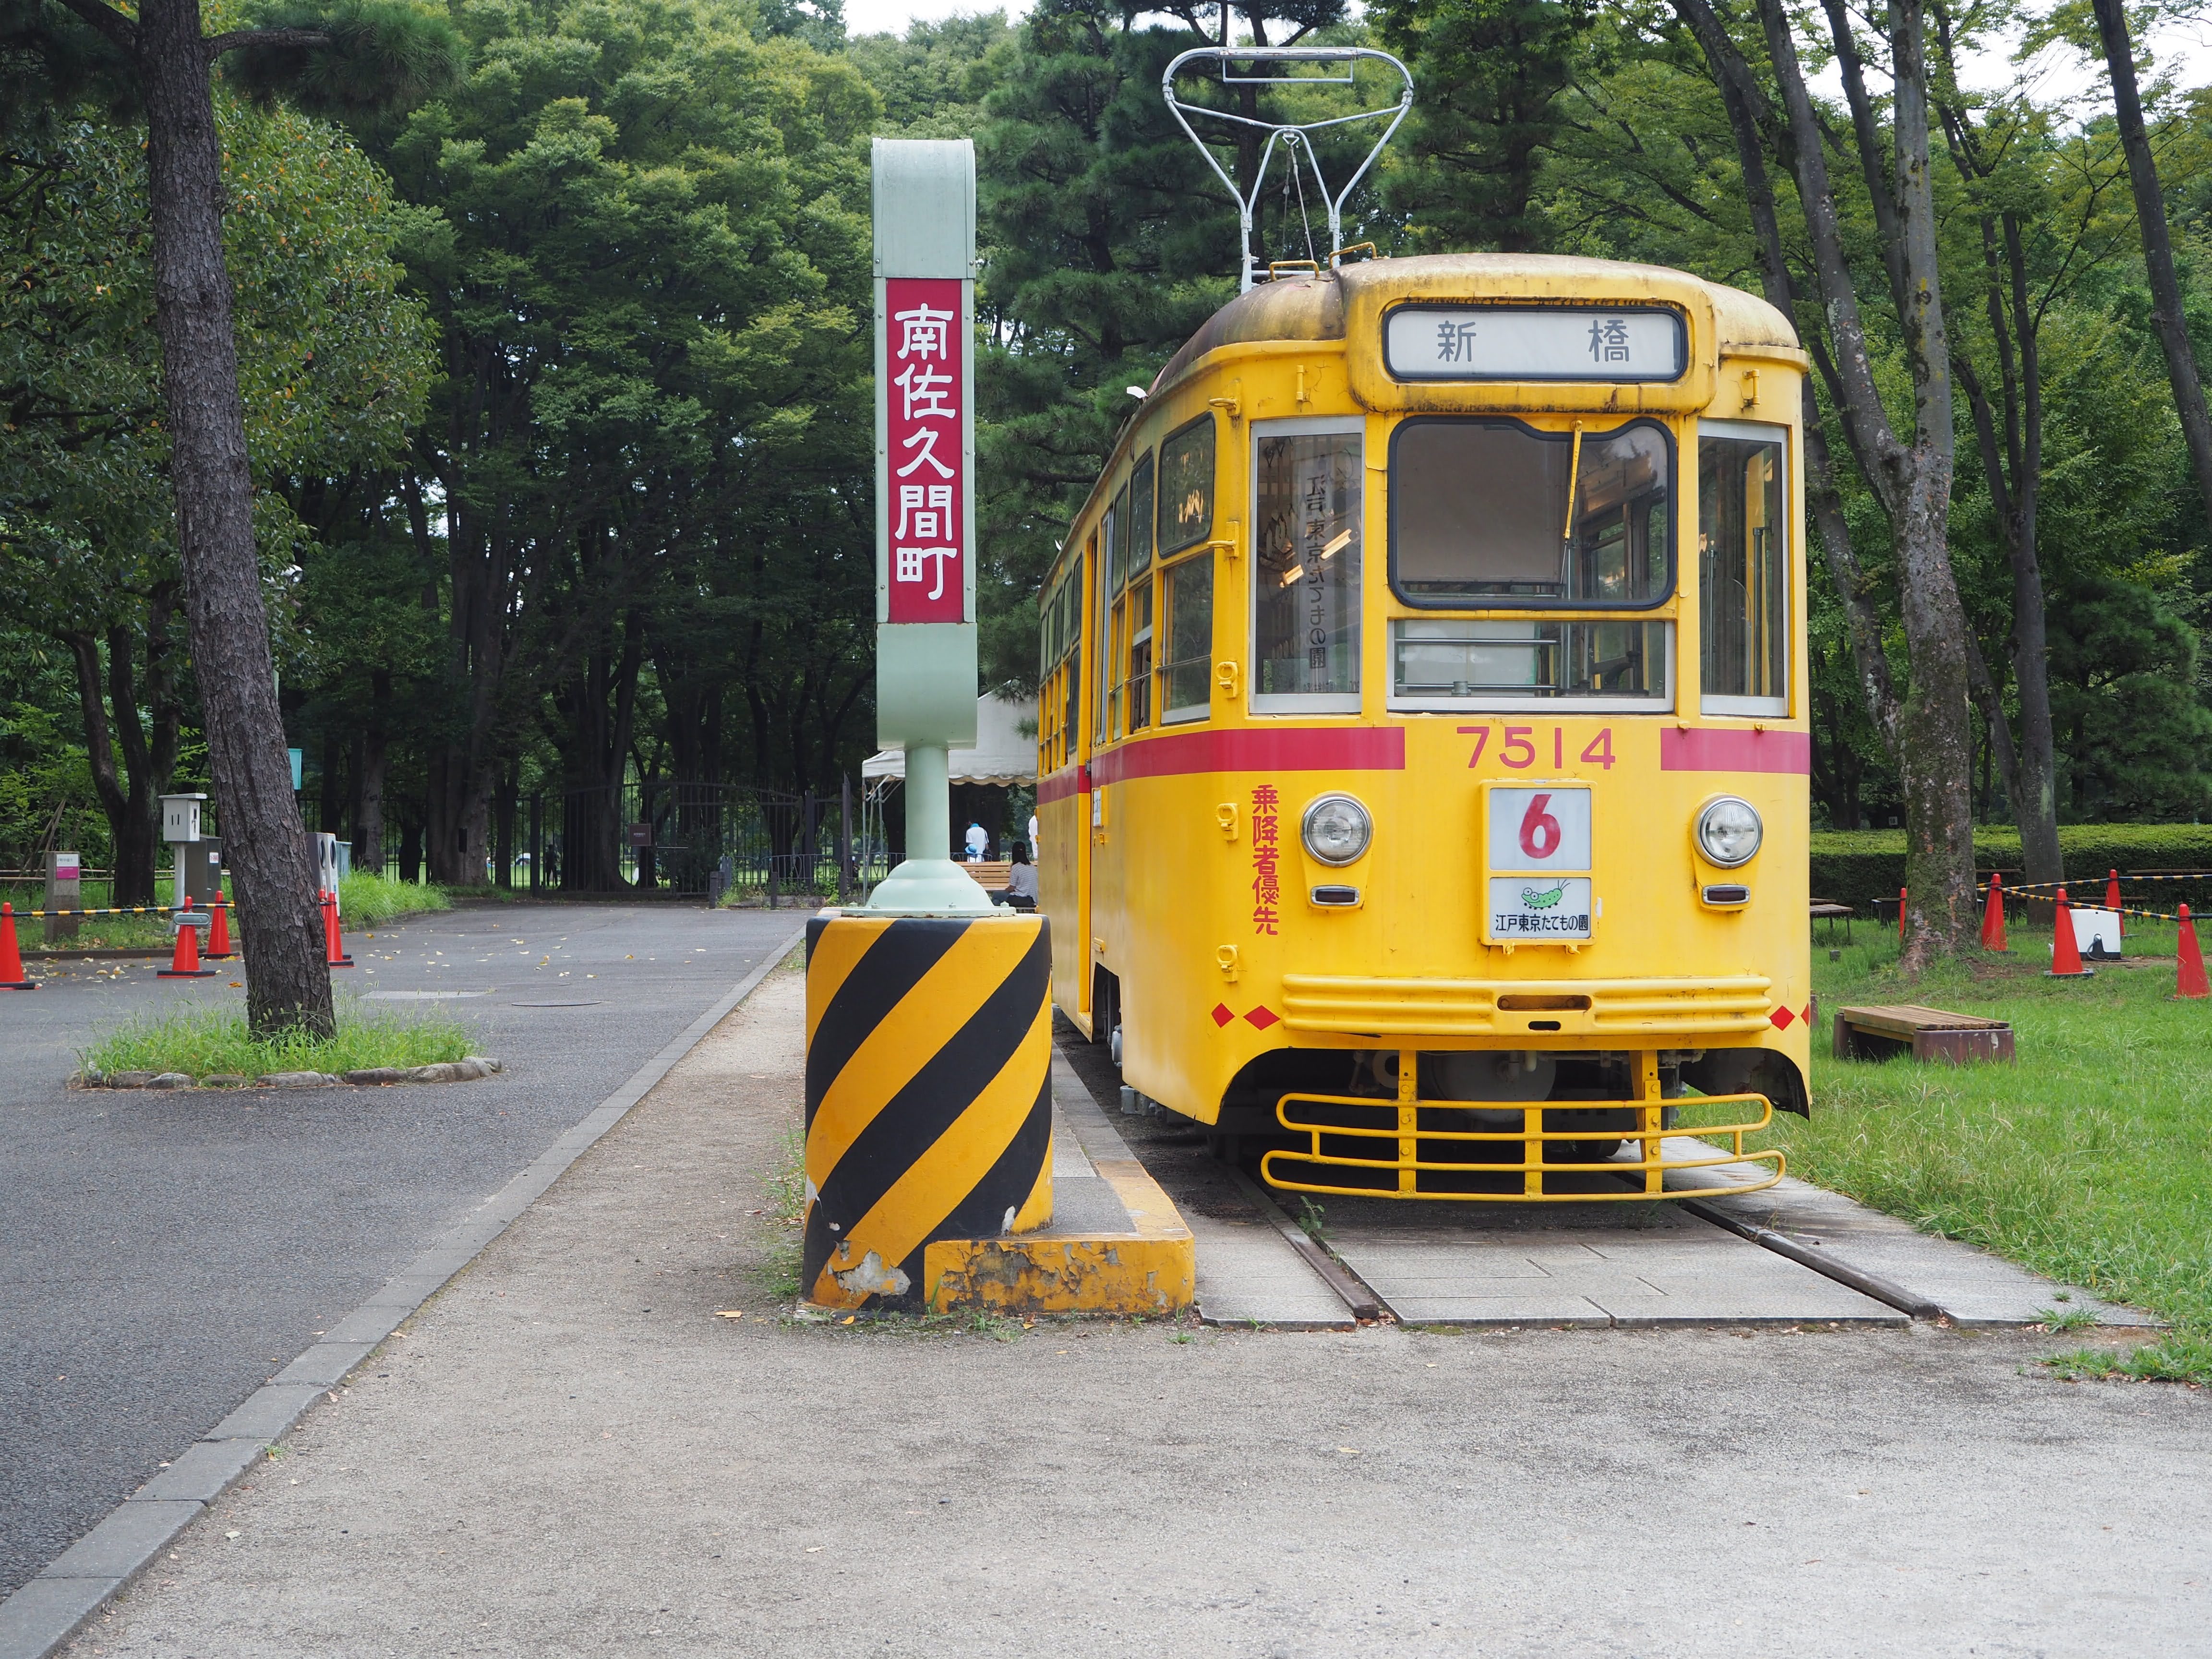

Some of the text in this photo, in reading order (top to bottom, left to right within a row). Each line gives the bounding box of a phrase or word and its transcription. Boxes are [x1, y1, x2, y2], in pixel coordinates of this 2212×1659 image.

[1437, 320, 1630, 362] 新橋
[893, 302, 958, 601] 南佐久間町
[1456, 726, 1616, 770] 7514
[1518, 793, 1561, 859] 6
[1251, 784, 1280, 936] 乗降者優先
[1495, 914, 1588, 932] 江戸東京たてもの園
